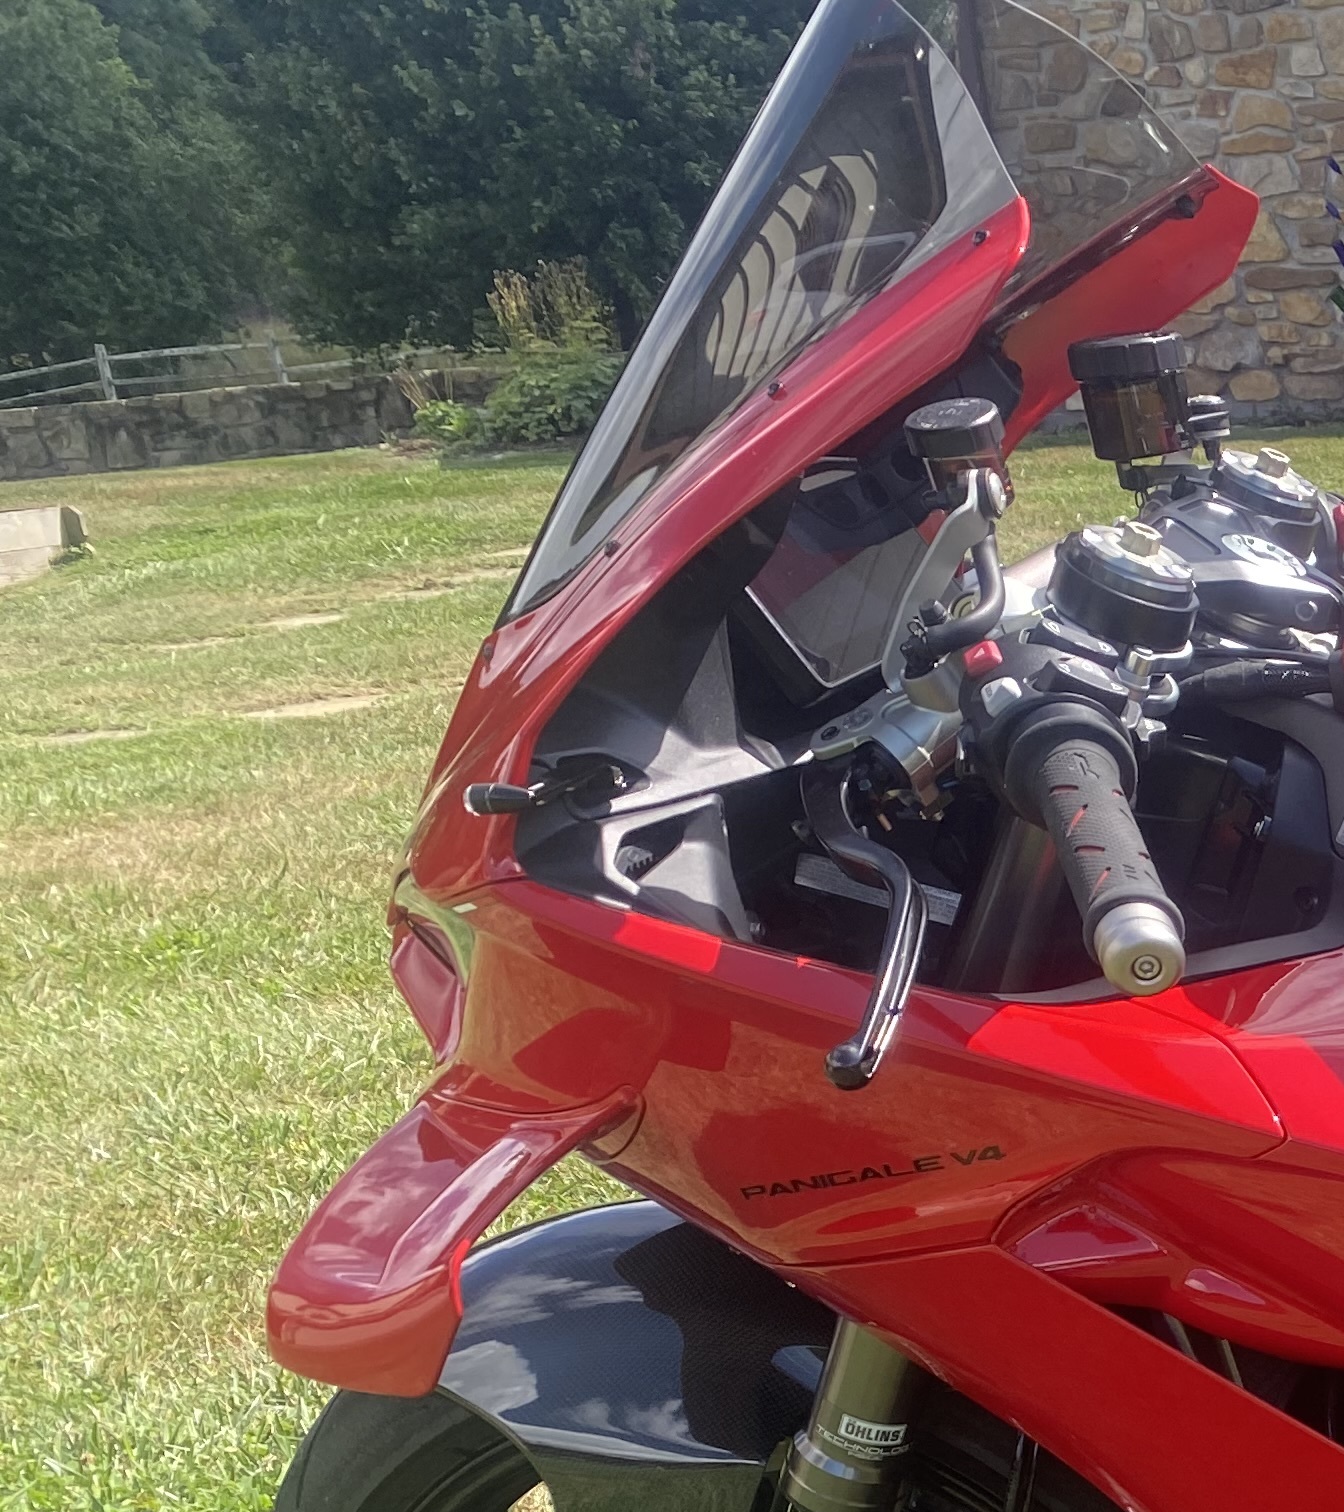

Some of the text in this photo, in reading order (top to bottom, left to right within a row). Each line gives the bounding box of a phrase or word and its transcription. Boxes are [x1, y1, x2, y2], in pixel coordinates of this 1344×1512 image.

[740, 1145, 1006, 1200] PANIGALE V4
[845, 1418, 901, 1442] ÖHLINS
